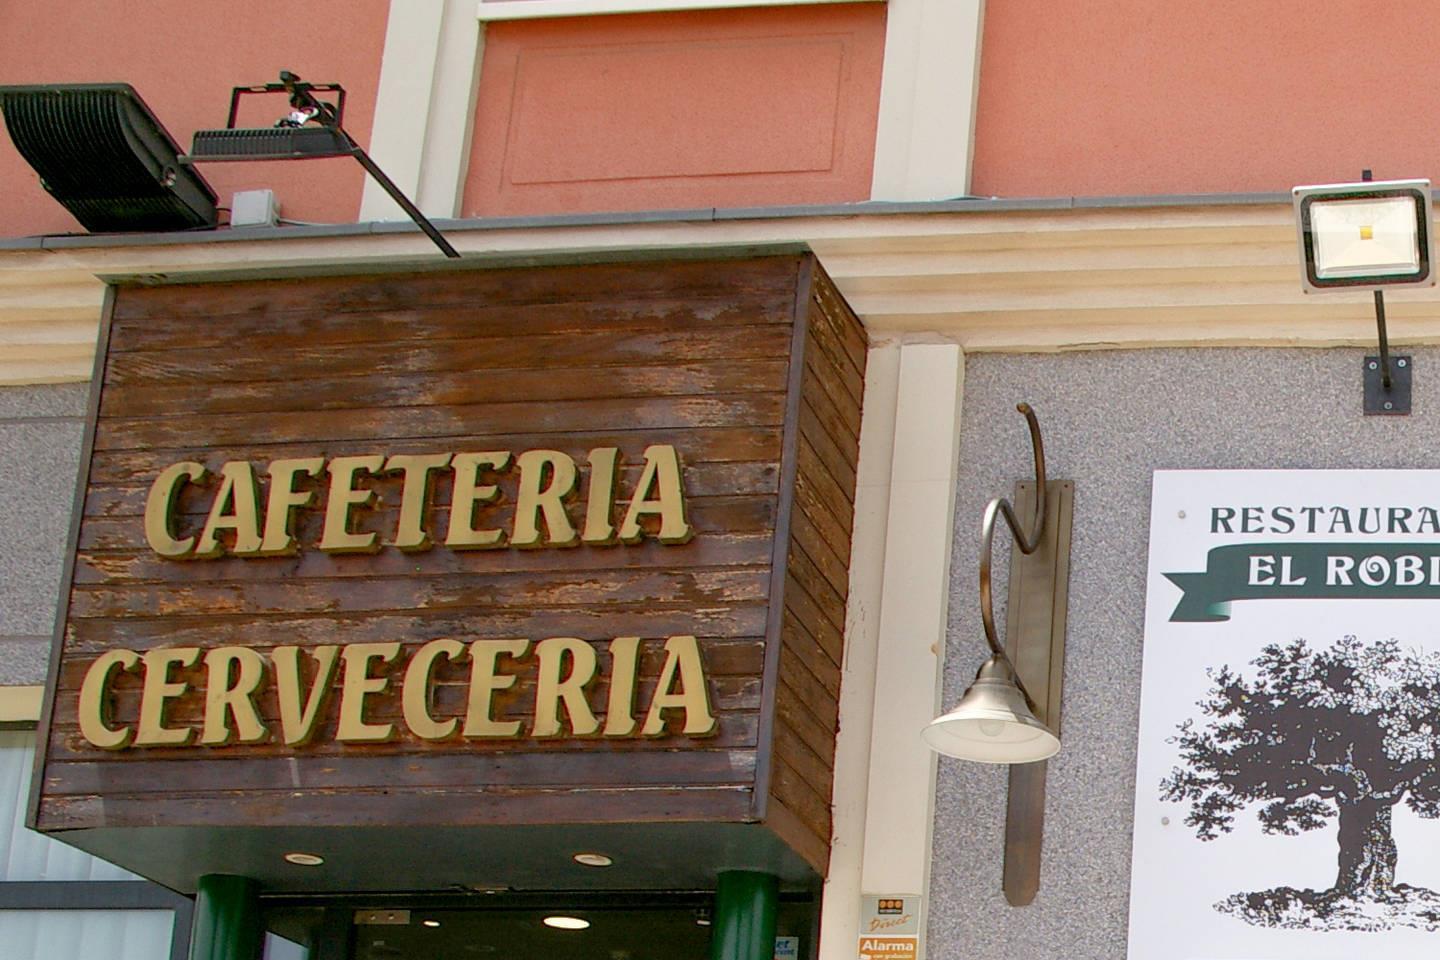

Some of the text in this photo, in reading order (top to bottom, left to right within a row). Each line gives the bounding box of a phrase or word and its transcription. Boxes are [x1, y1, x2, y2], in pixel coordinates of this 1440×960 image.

[144, 445, 693, 560] CAFETERIA
[1247, 555, 1307, 586] EL
[77, 635, 718, 751] CERVECERIA
[862, 939, 914, 951] Alarma
